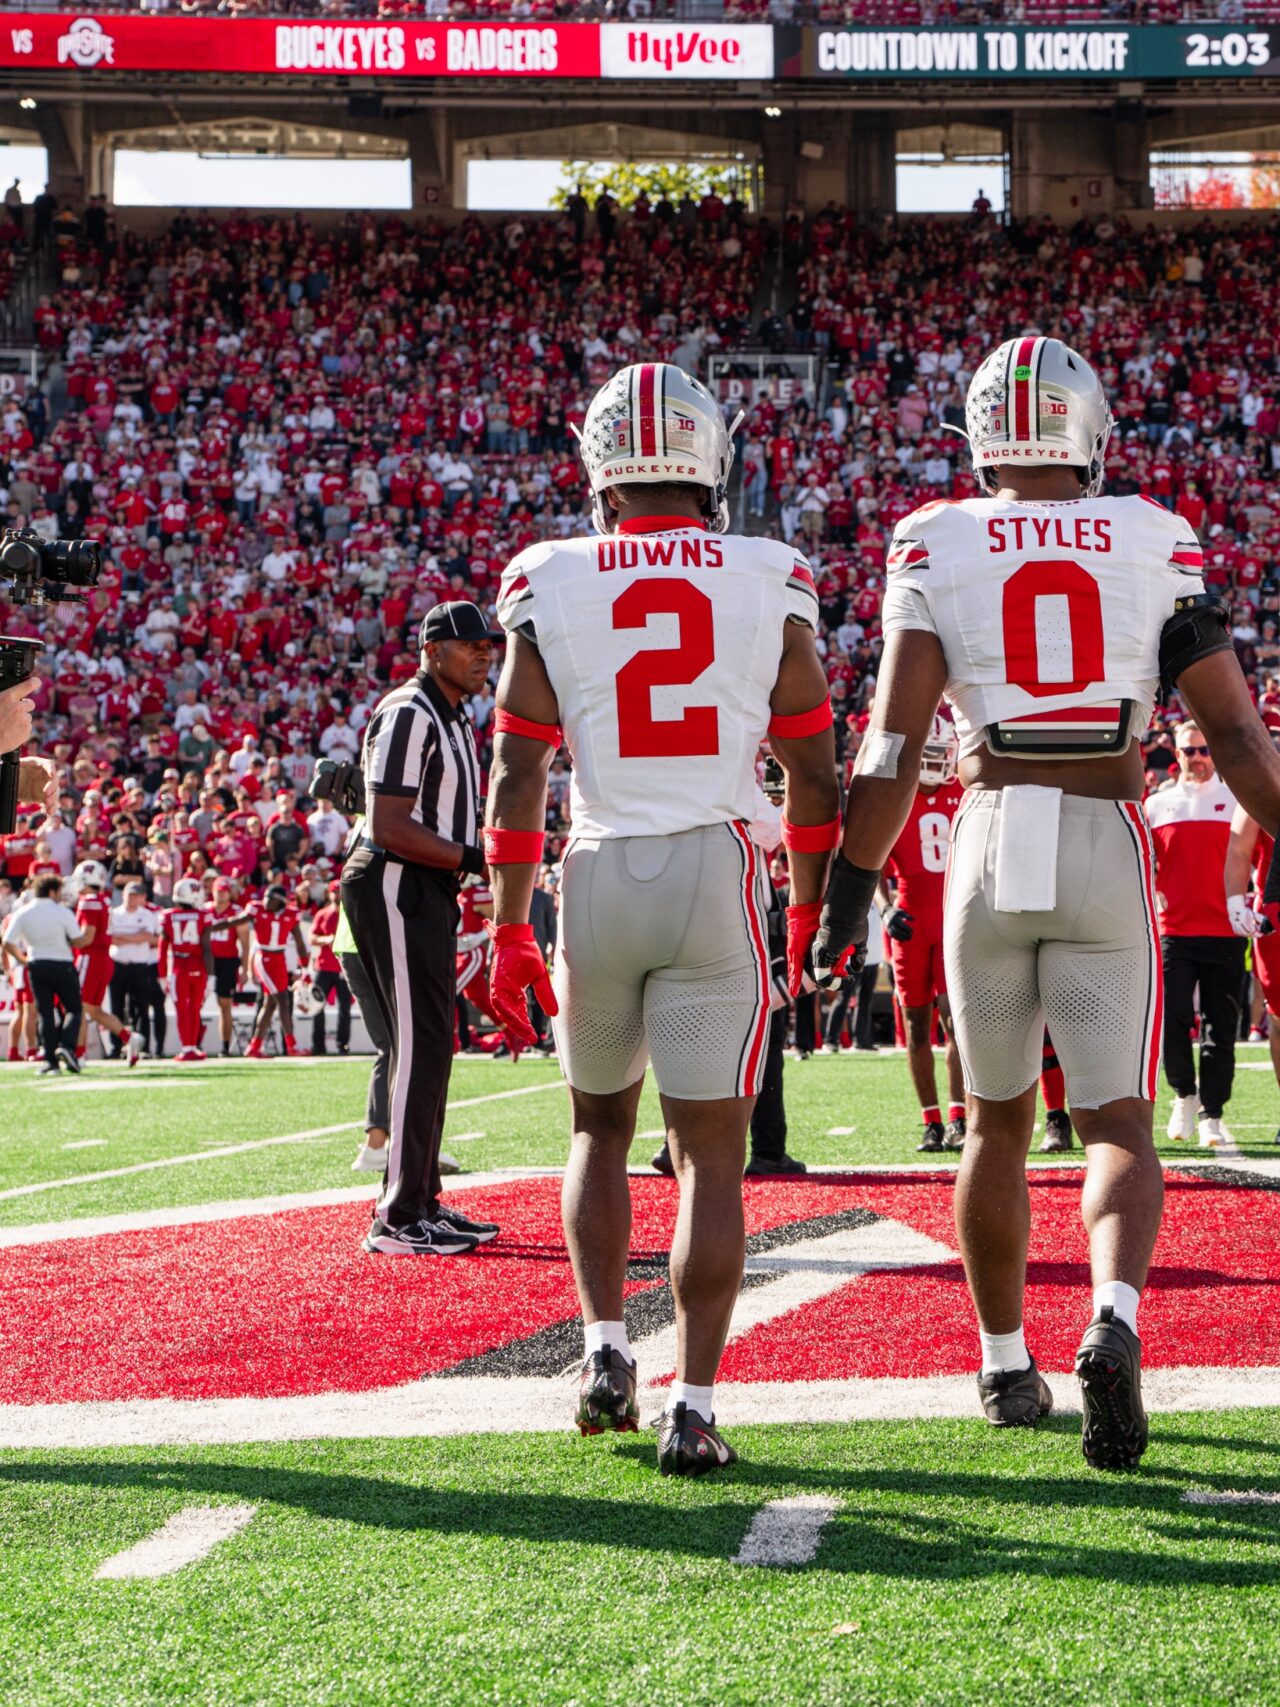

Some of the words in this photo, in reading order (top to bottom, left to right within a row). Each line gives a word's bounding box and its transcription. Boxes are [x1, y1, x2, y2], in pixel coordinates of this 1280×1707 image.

[11, 29, 33, 53] VS
[275, 25, 405, 70] BUCKEYES
[415, 37, 436, 61] VS
[447, 28, 558, 71] BADGERS
[818, 32, 977, 71] COUNTDOWN
[985, 32, 1018, 71] TO
[1025, 32, 1128, 71] KICKOFF
[1185, 33, 1270, 66] 2:03
[729, 380, 744, 398] D
[781, 380, 794, 398] E
[618, 434, 626, 446] 2
[983, 449, 1069, 459] BUCKEYES
[604, 465, 697, 477] BUCKEYES
[987, 517, 1111, 552] STYLES
[598, 539, 724, 572] DOWNS
[1002, 560, 1105, 698] 0
[612, 577, 720, 758] 2
[450, 737, 458, 751] S
[918, 812, 950, 873] 8
[173, 920, 199, 945] 14
[270, 921, 281, 950] 1
